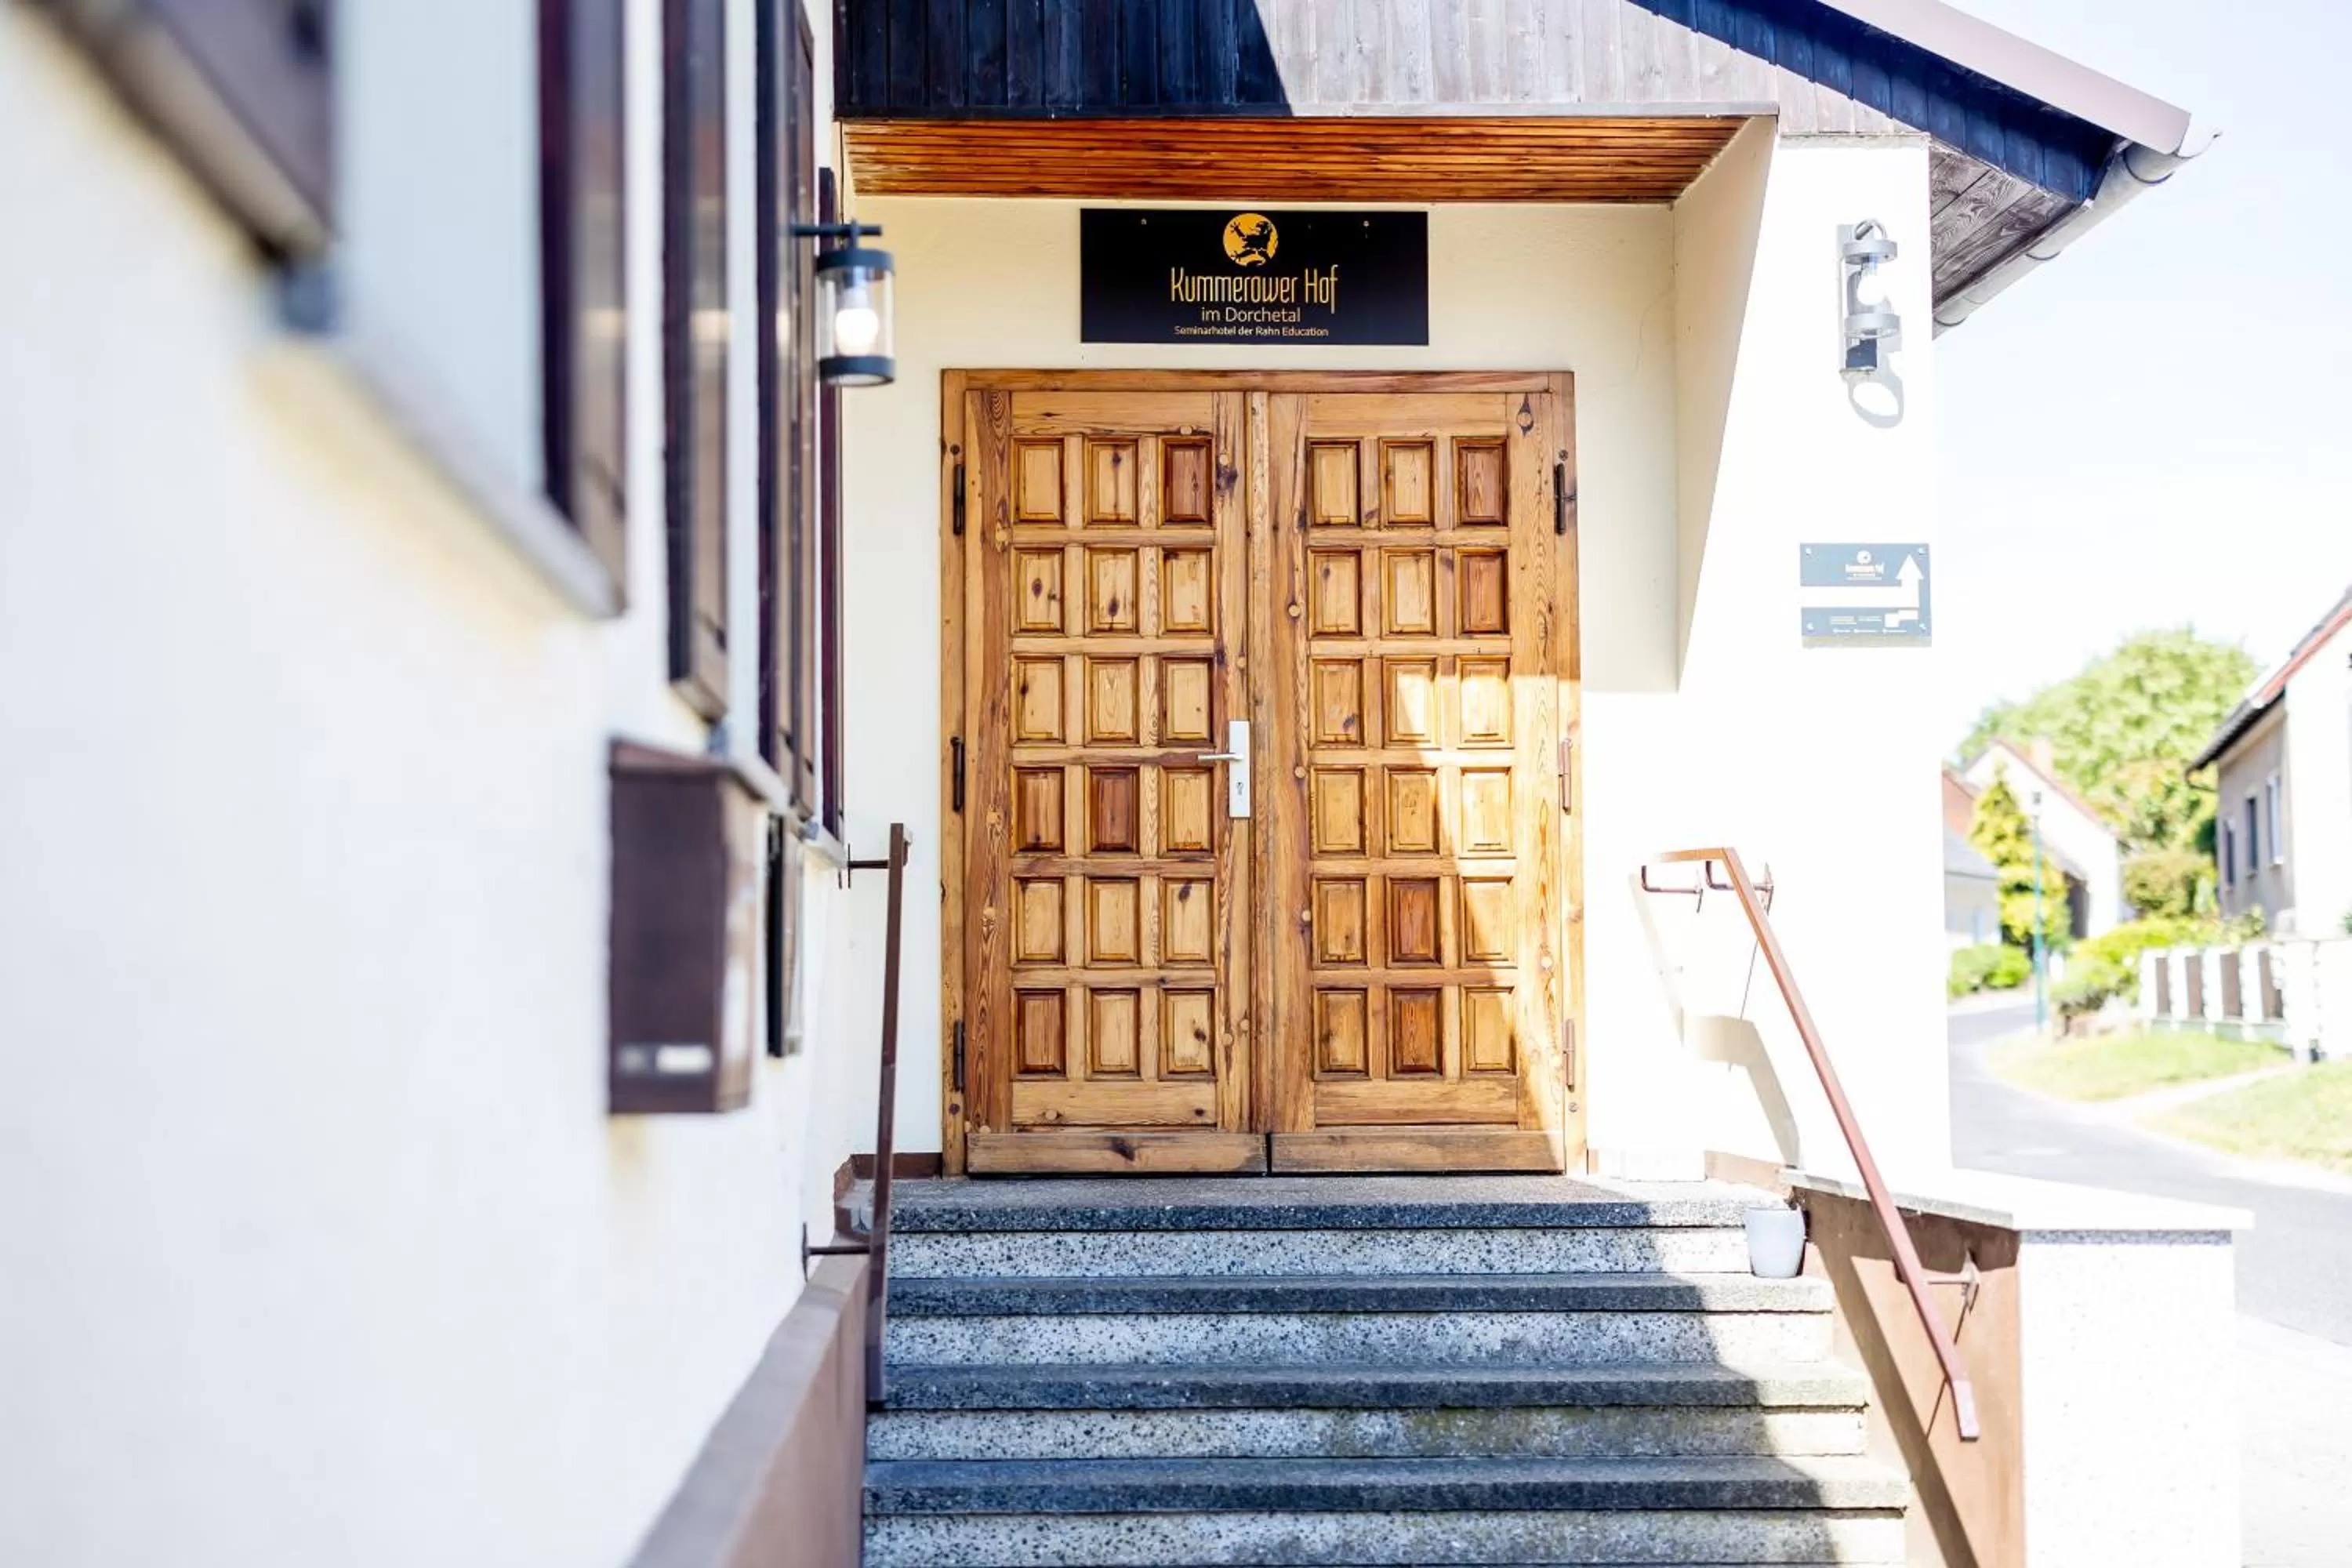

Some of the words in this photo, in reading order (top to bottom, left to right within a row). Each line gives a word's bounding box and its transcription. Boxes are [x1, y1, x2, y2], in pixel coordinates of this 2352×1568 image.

[1171, 267, 1298, 303] Kummerower
[1304, 264, 1339, 314] Hof
[1201, 307, 1221, 322] im
[1225, 307, 1301, 322] Dorchetal
[1174, 326, 1236, 336] Seminarhotel
[1238, 326, 1252, 336] der
[1255, 326, 1280, 336] Rahn
[1282, 327, 1329, 336] Education
